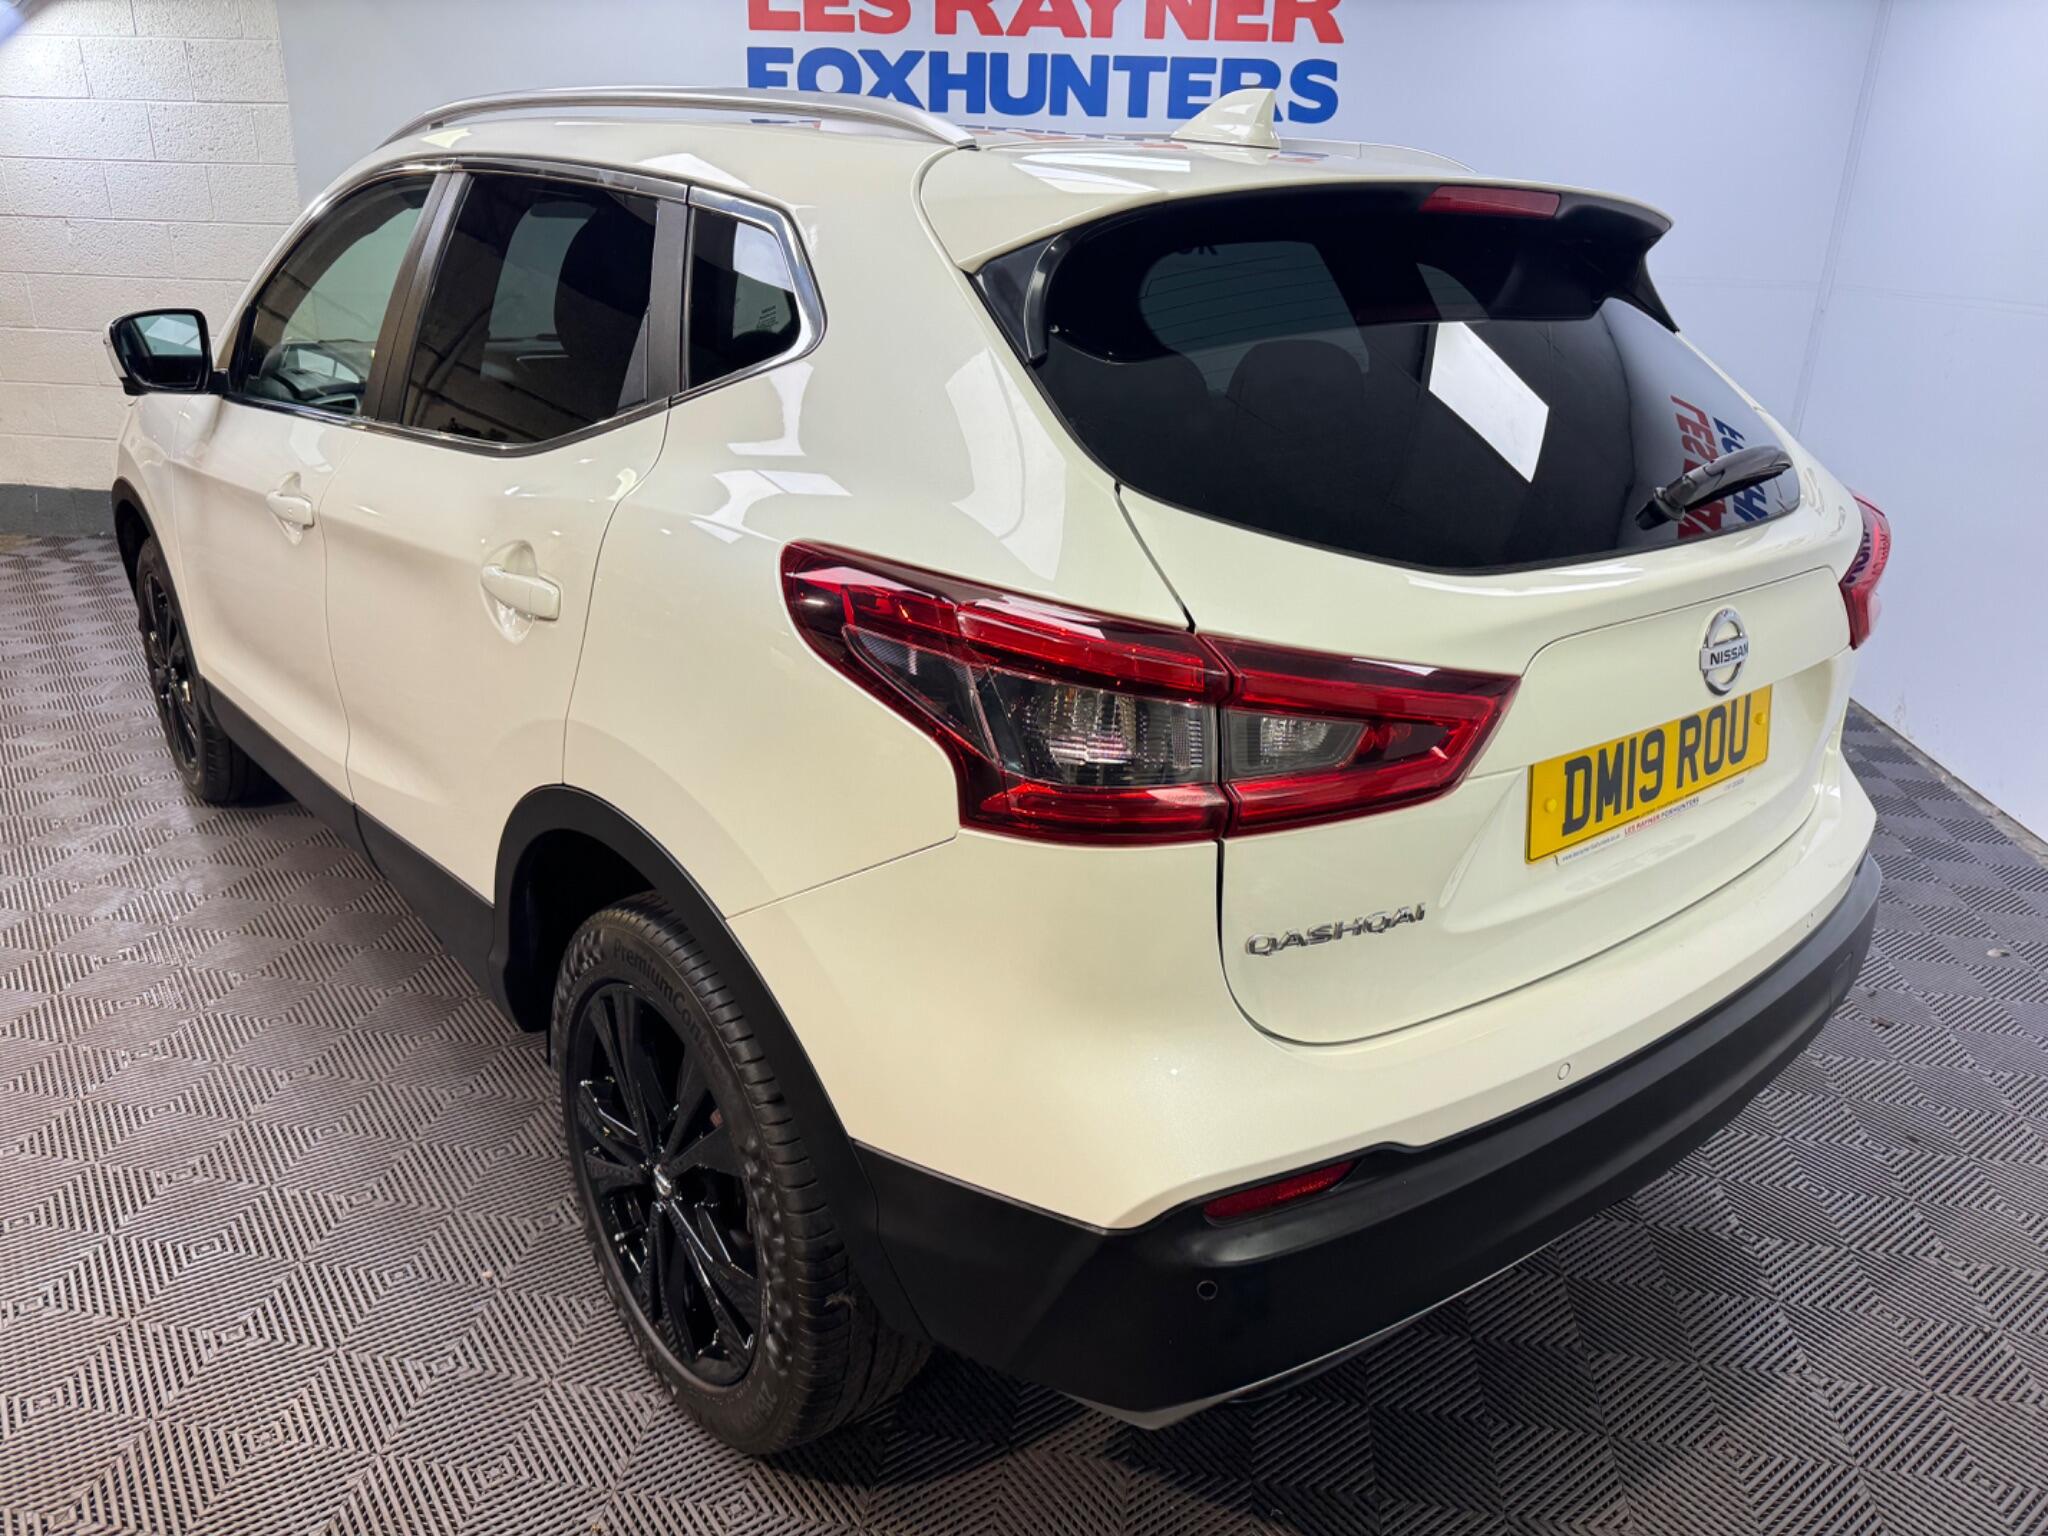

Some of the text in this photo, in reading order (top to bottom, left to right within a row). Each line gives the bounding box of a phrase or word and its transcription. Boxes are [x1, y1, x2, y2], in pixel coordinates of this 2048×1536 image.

[935, 0, 1344, 43] RAYNER
[747, 47, 1339, 124] FOXHUNTERS
[1710, 642, 1748, 666] NISSAN
[1562, 693, 1751, 836] DM19 ROU
[1245, 902, 1426, 956] QASHQAI
